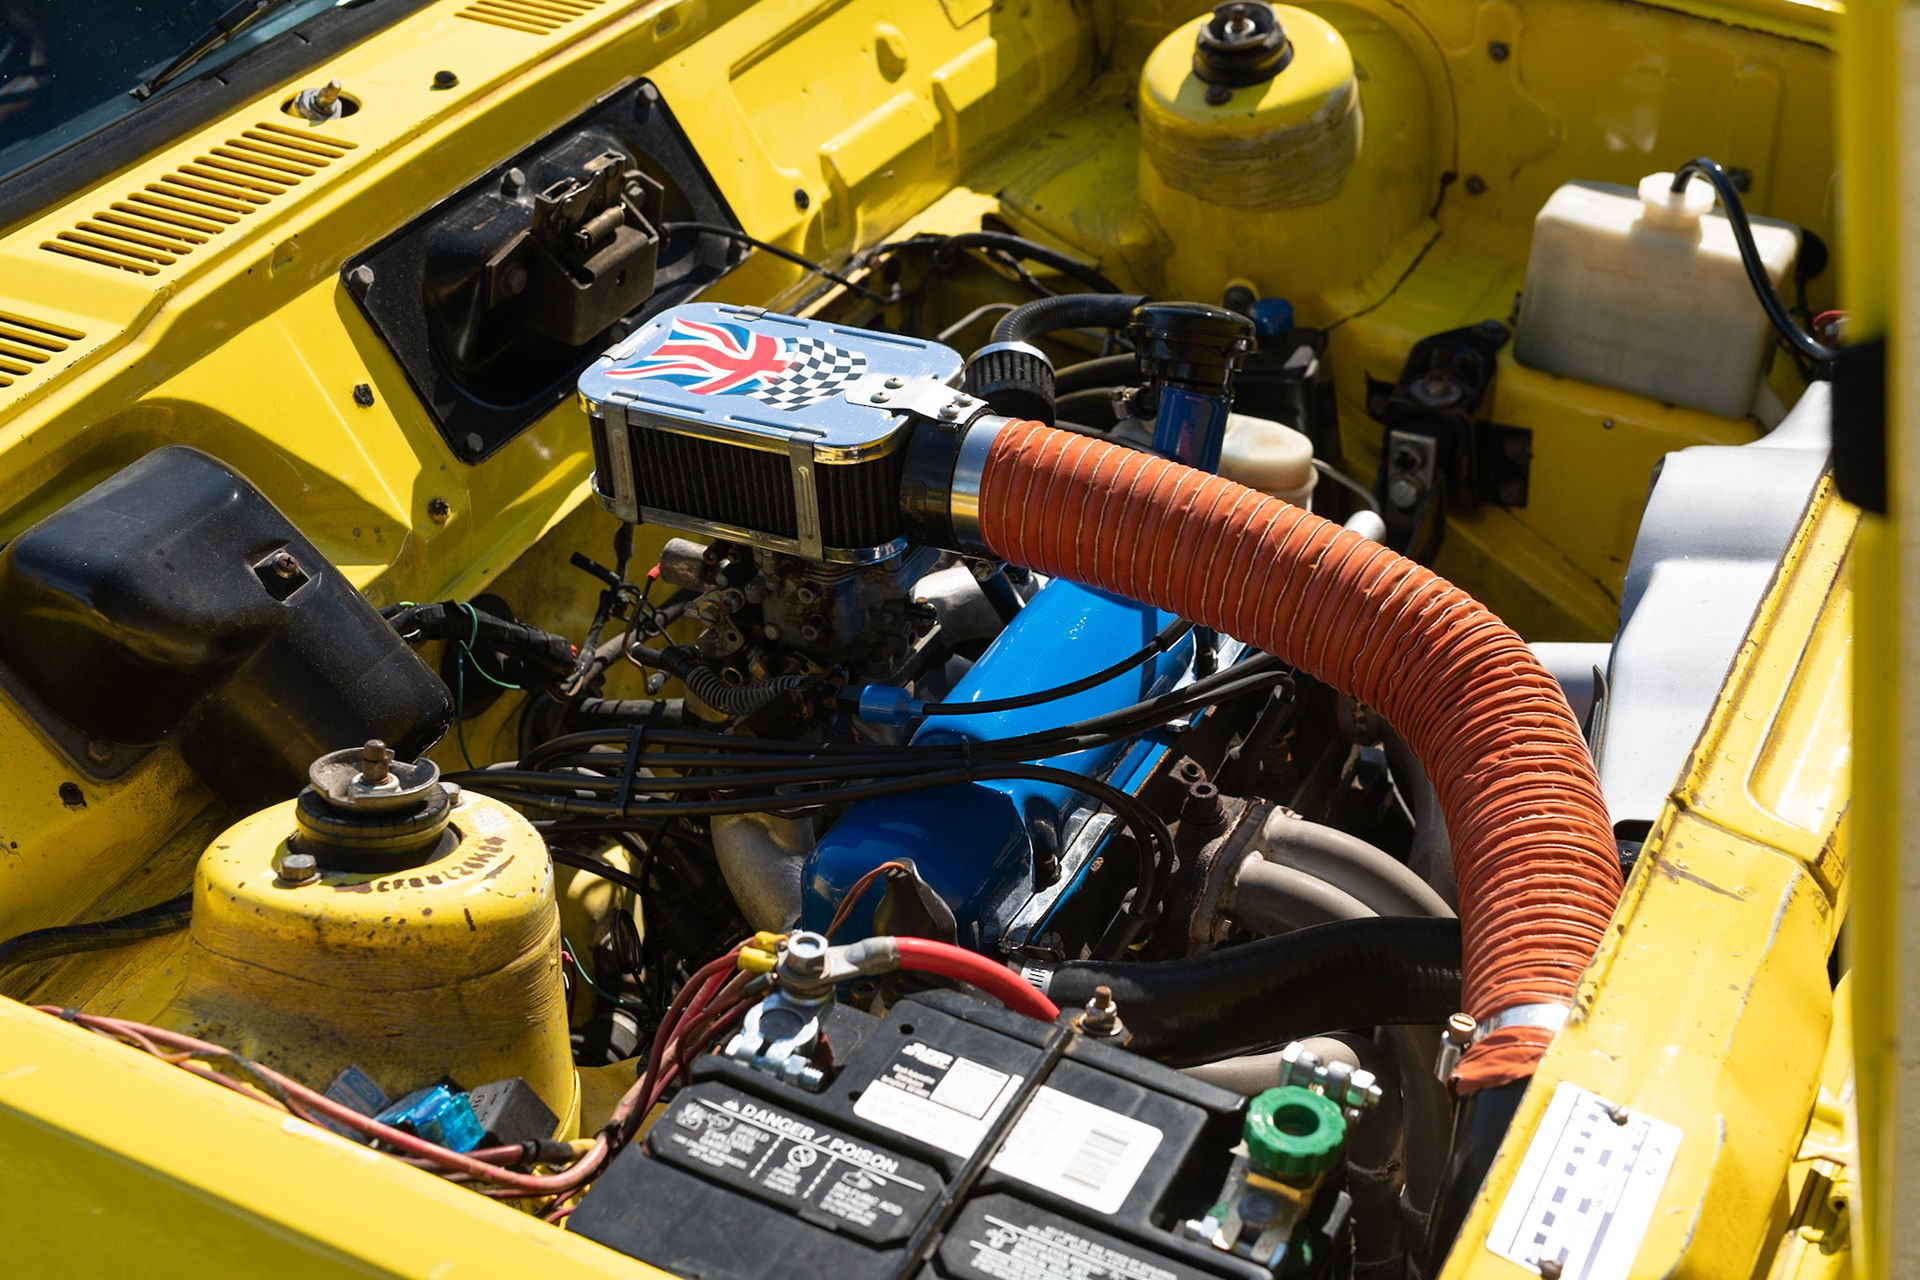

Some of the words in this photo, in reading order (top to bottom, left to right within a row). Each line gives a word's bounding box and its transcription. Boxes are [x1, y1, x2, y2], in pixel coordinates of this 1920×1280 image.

[741, 1103, 816, 1141] DANGER
[813, 1134, 831, 1144] /
[829, 1138, 899, 1174] POISON
